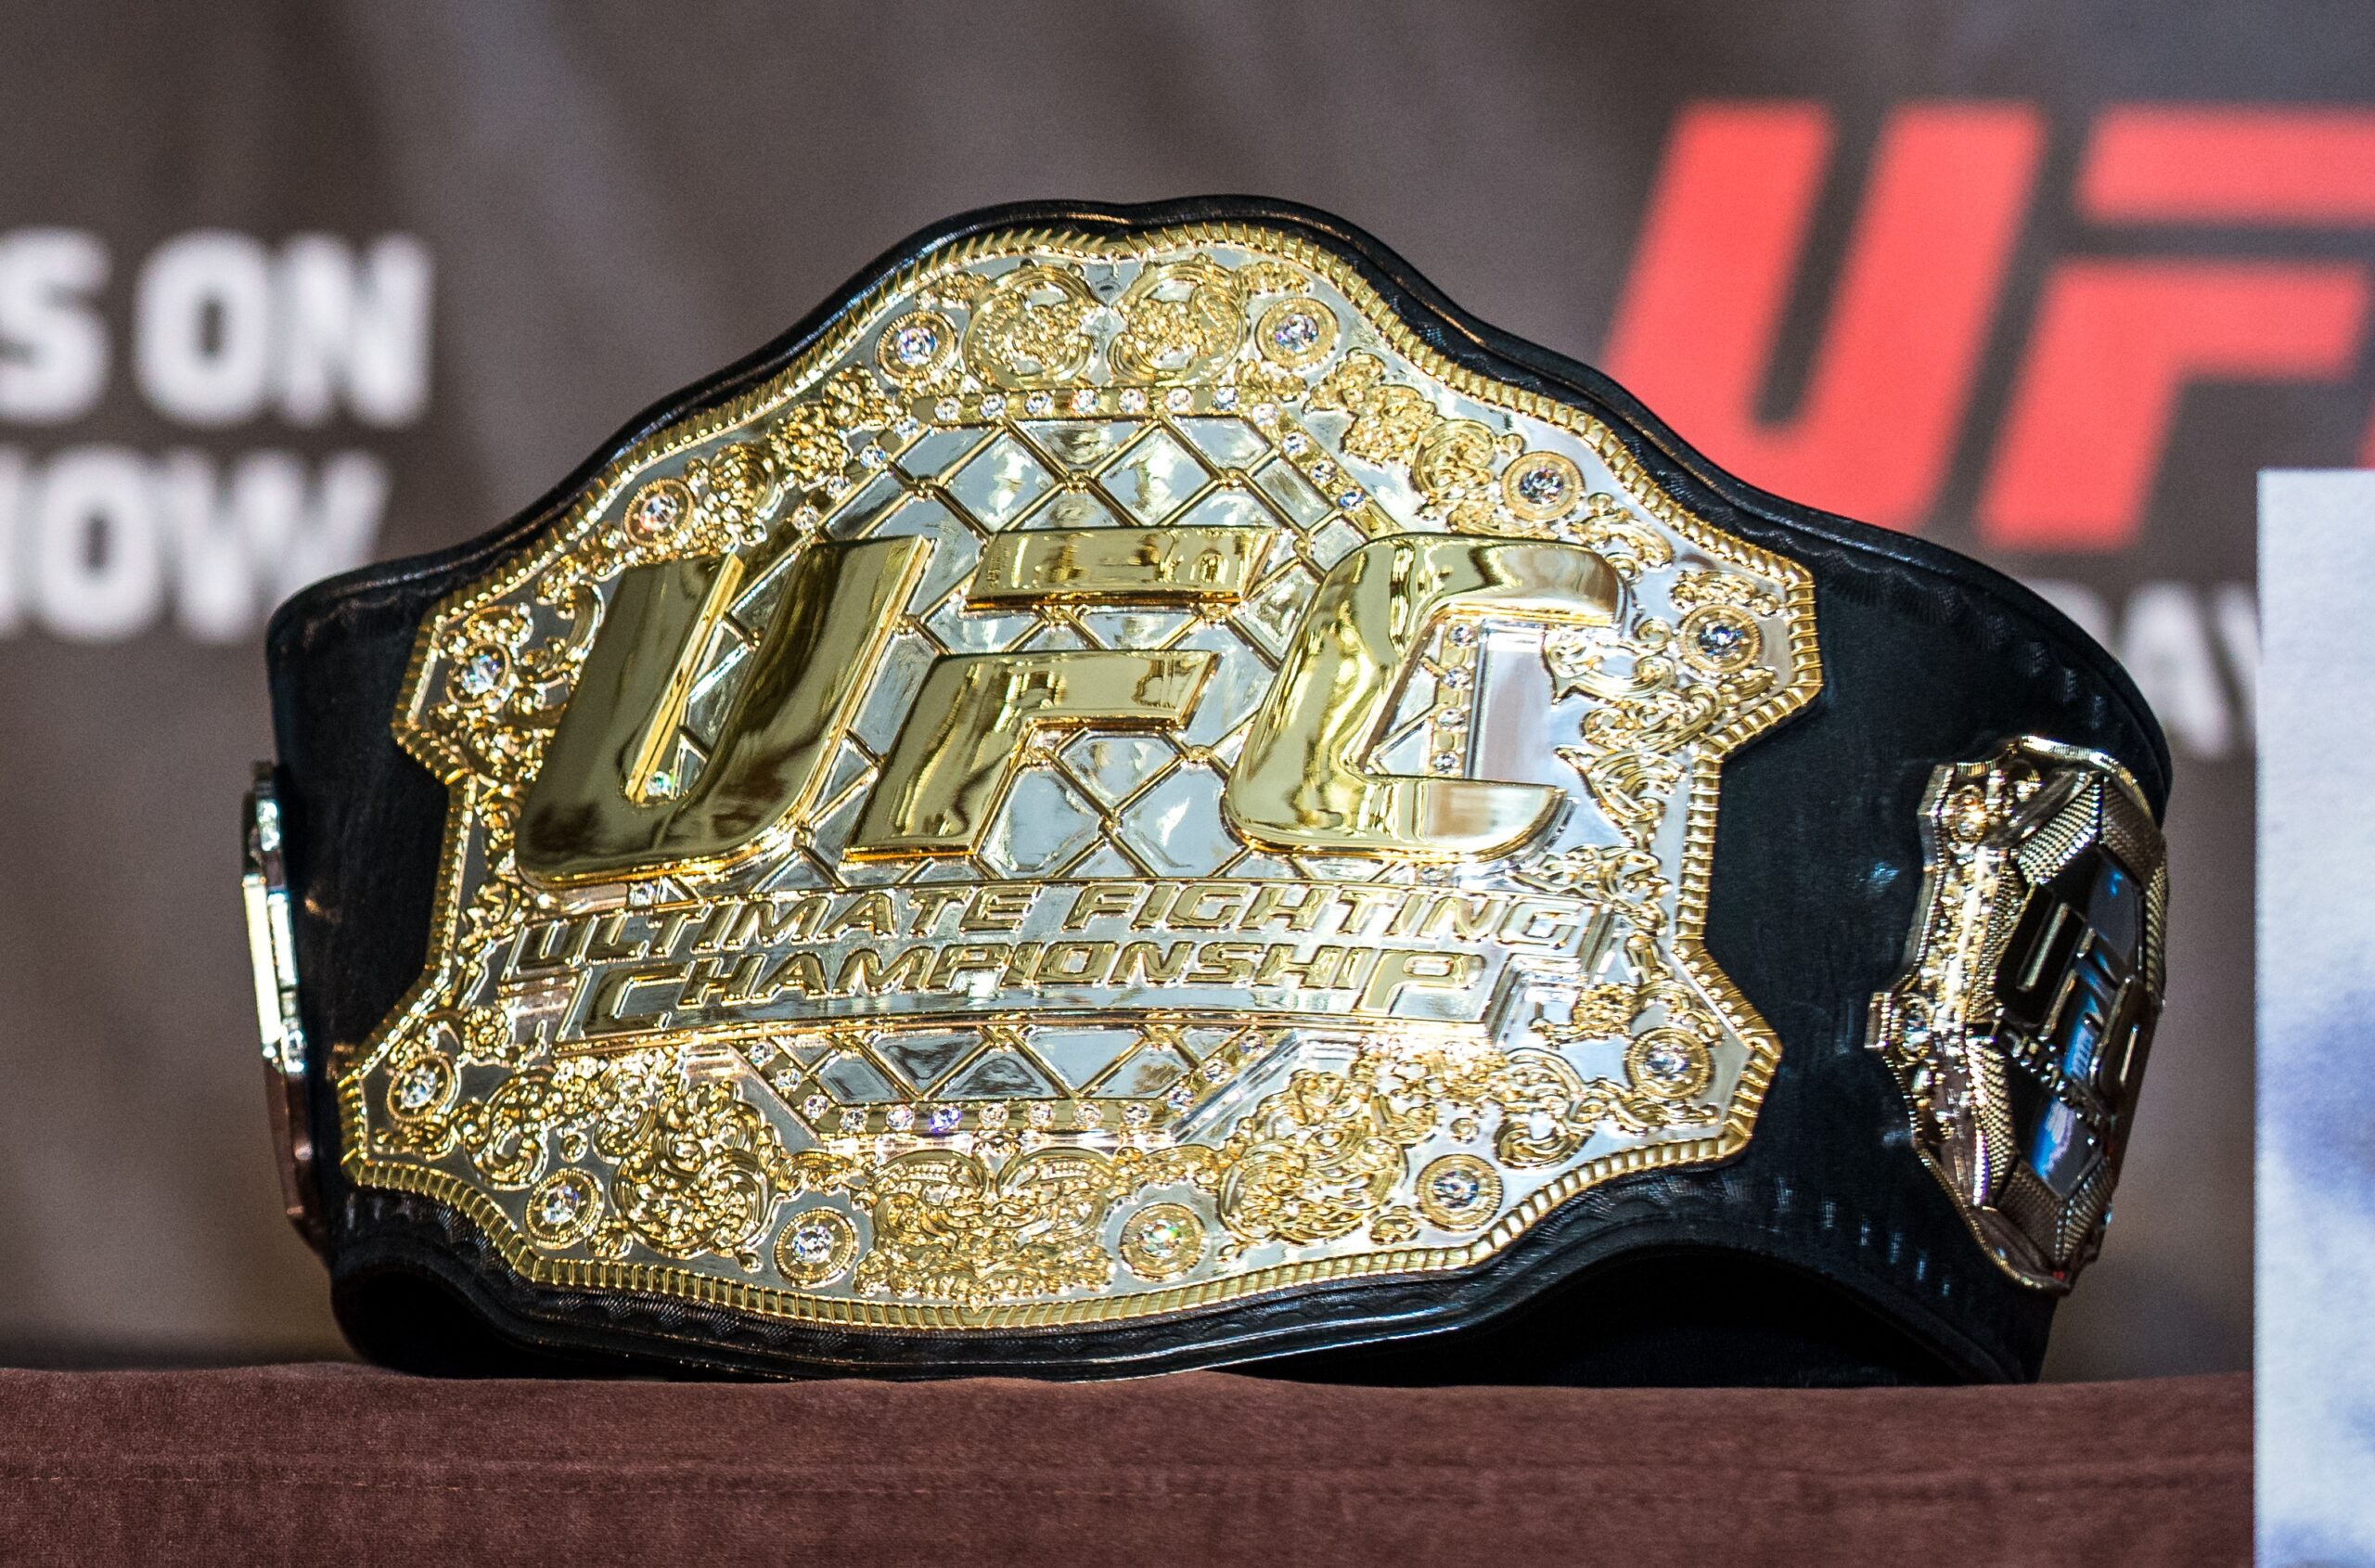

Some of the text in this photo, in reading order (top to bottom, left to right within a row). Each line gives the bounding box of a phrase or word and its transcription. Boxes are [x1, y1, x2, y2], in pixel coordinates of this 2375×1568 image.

[135, 232, 432, 427] ON
[1603, 104, 2375, 547] UF
[0, 445, 388, 640] OW
[516, 531, 1627, 881] UFC
[506, 883, 1598, 980] ULTIMATE FIGHTING
[560, 939, 1486, 1037] CHAMPIONSHIP
